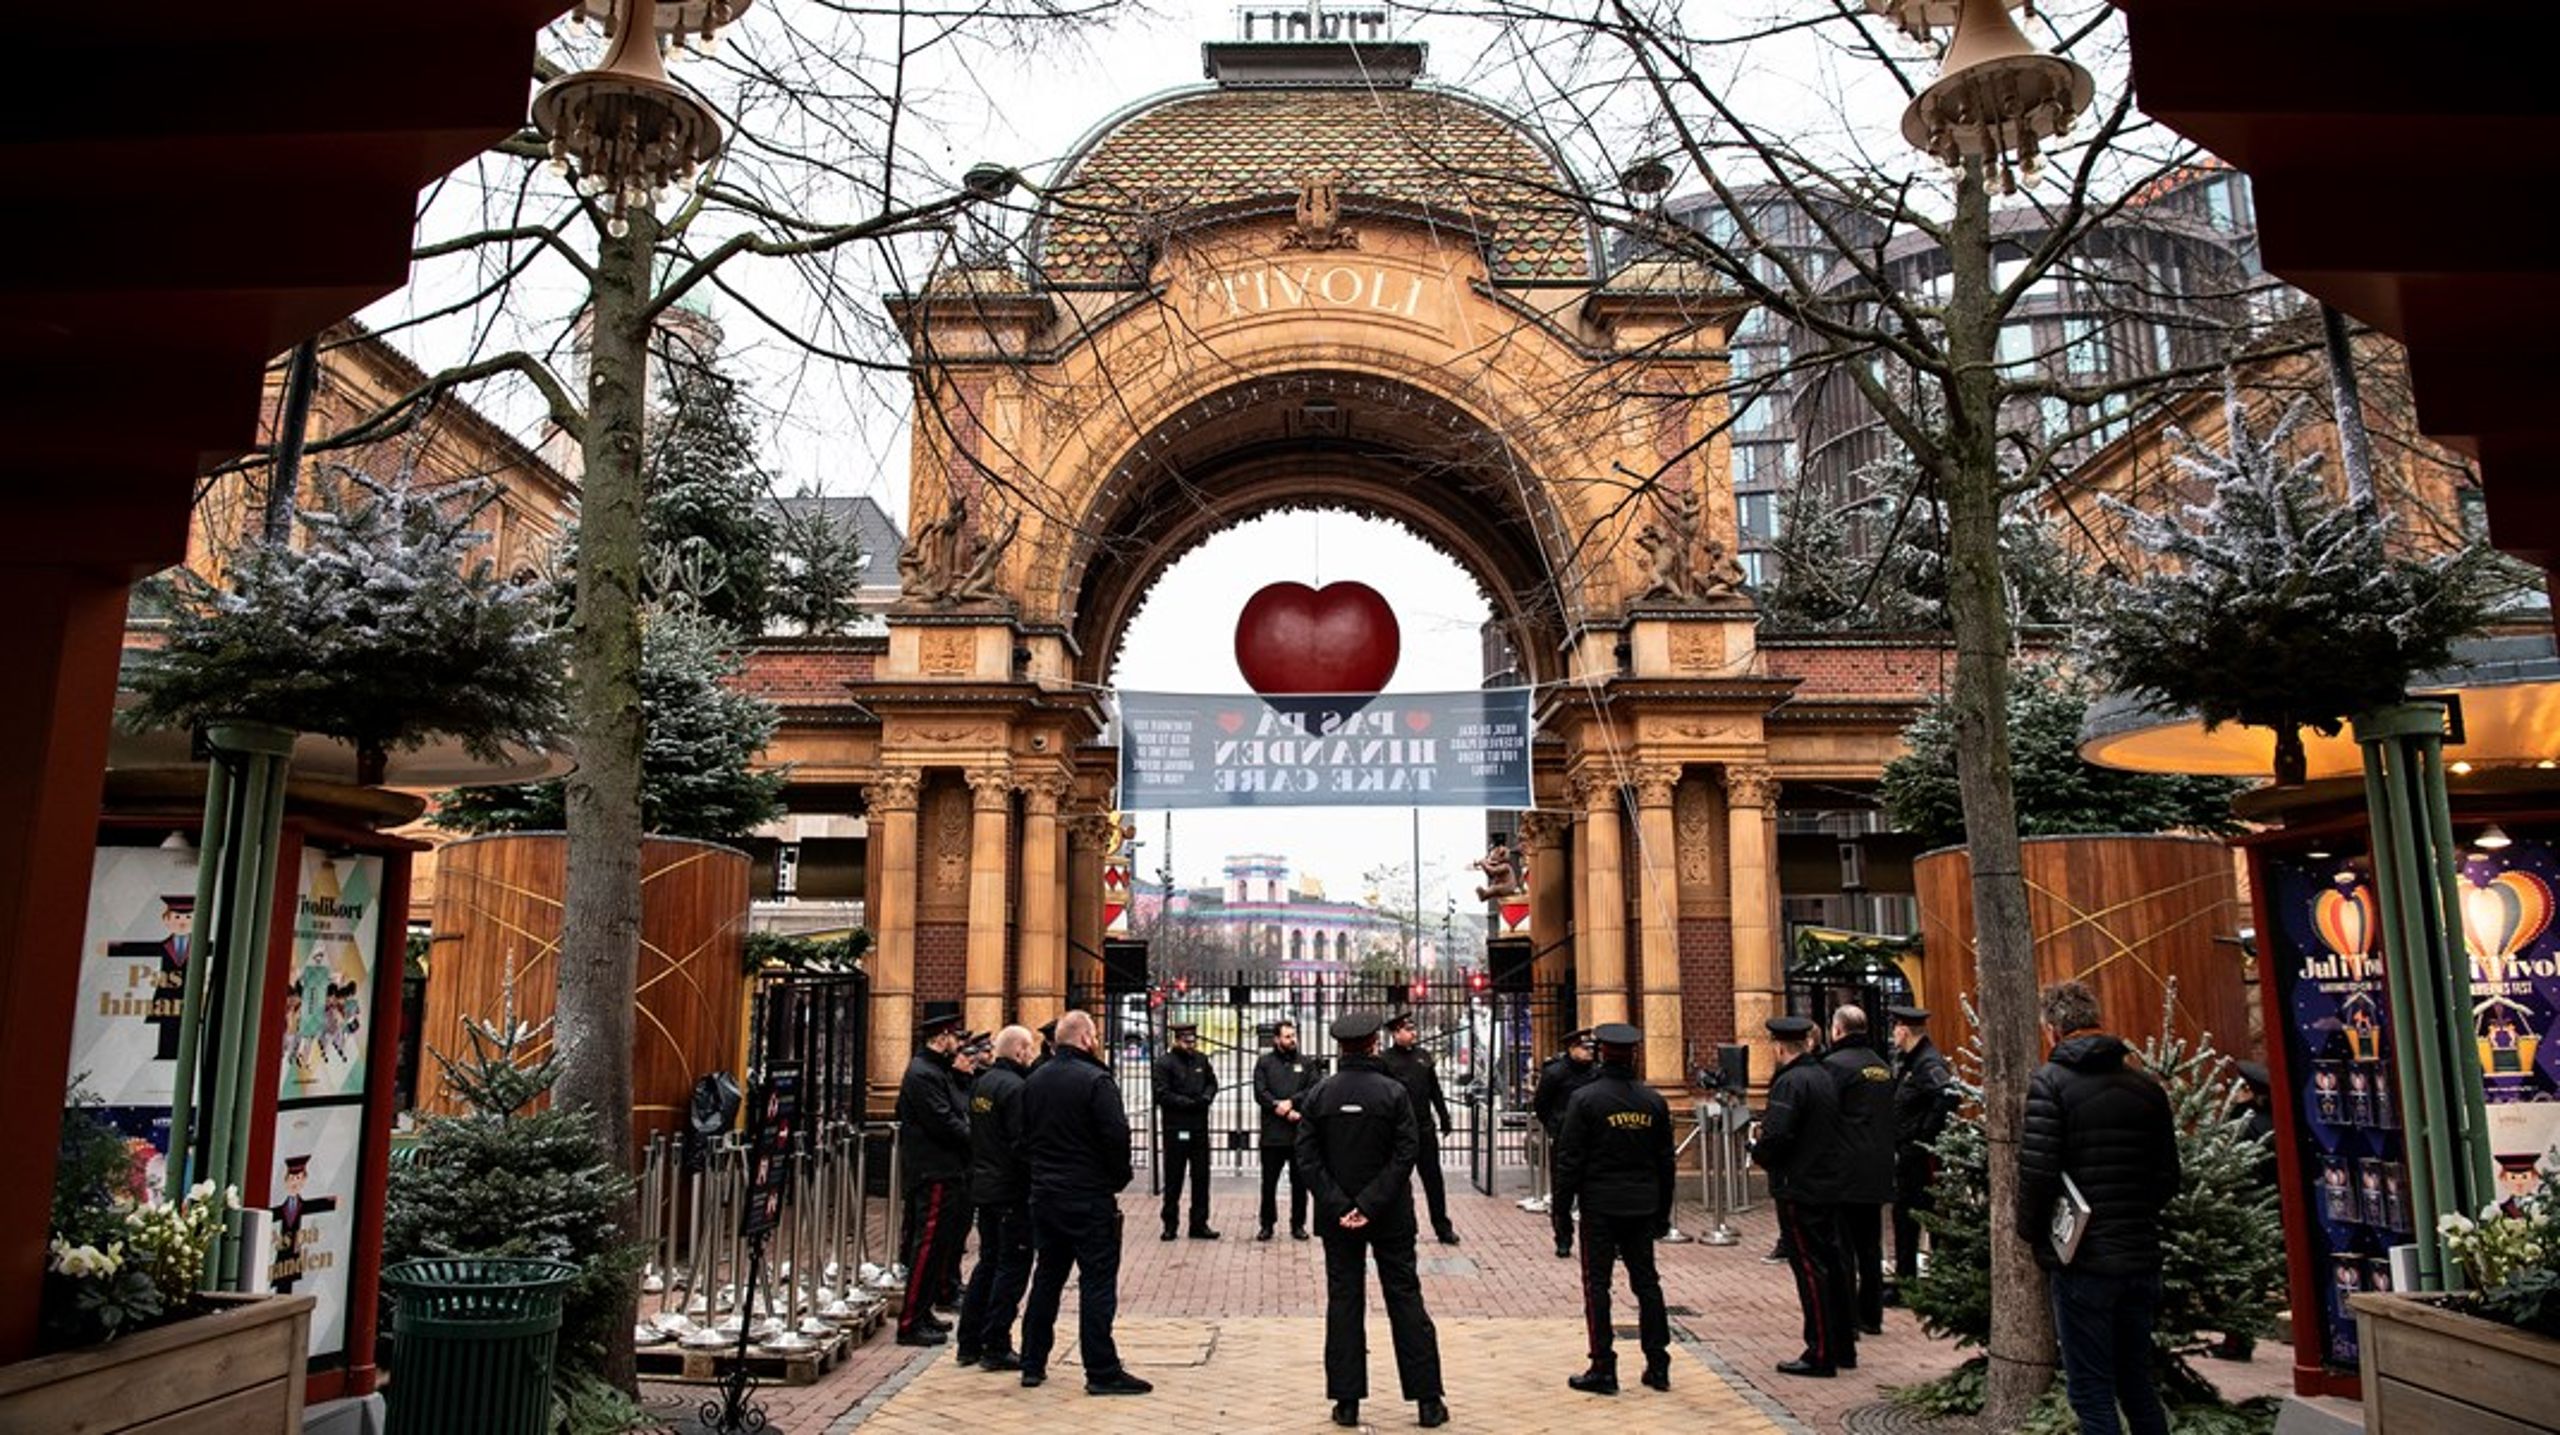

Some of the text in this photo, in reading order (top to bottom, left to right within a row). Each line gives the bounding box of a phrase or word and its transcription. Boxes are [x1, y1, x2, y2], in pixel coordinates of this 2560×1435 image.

[1207, 266, 1421, 316] TIVOLI
[298, 894, 363, 920] ivolikort
[129, 964, 183, 989] Pas
[2299, 954, 2338, 979] Jul
[2340, 954, 2349, 978] i
[1607, 1111, 1652, 1127] TIVOLI
